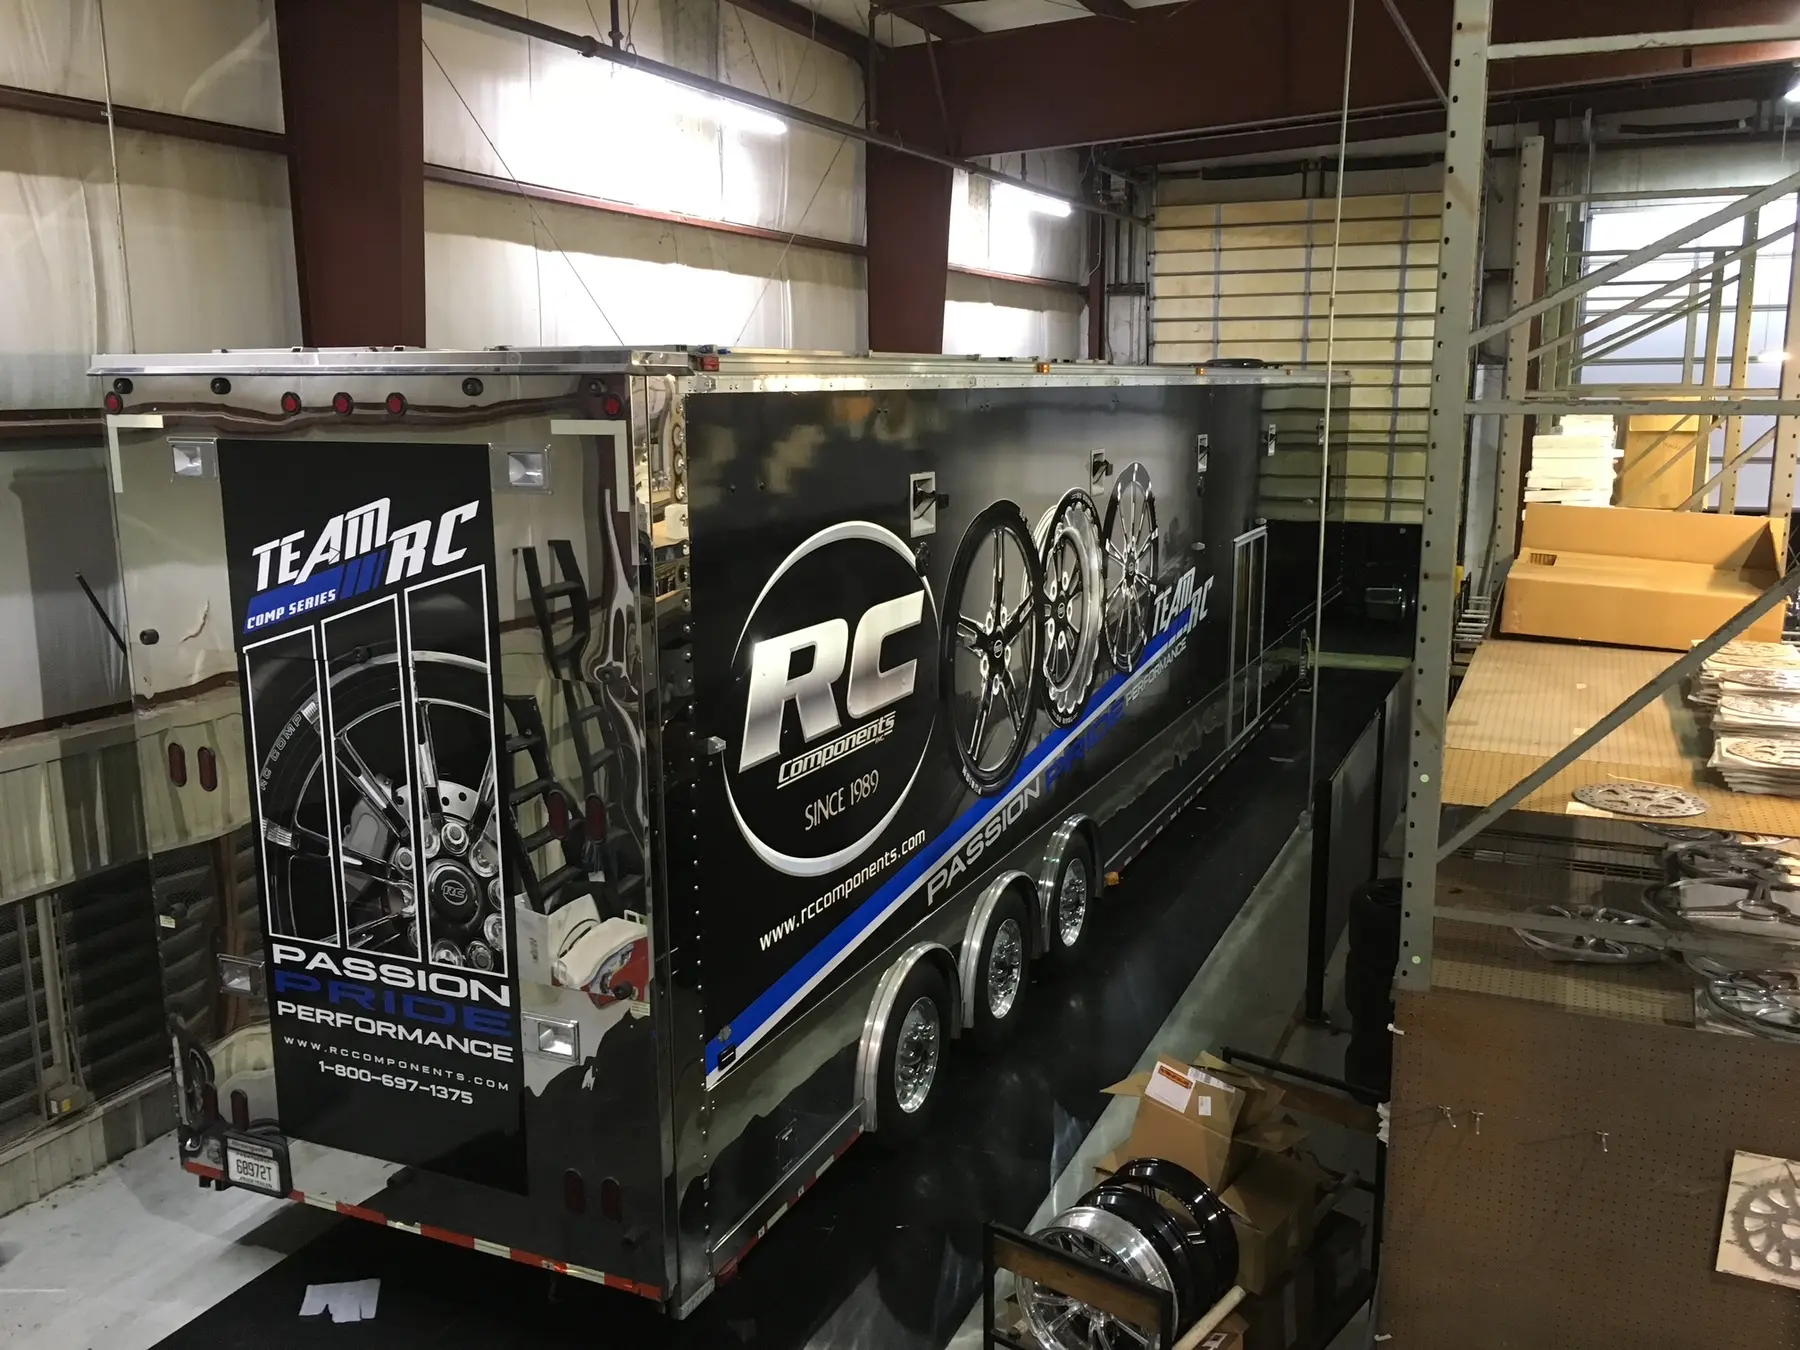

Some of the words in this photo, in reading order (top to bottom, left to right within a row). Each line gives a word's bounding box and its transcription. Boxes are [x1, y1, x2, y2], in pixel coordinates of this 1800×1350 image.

[252, 497, 391, 592] TEAM
[385, 500, 480, 585] RC
[246, 607, 285, 630] COMP
[288, 588, 337, 617] SERIES
[1152, 566, 1196, 638] TEAM
[1187, 574, 1214, 634] RC
[739, 589, 926, 775] RC
[270, 713, 302, 762] COMP
[804, 787, 846, 831] SINCE
[850, 769, 879, 806] 1989
[927, 774, 1041, 906] PASSION
[1044, 693, 1126, 793] PRIDE
[1125, 636, 1187, 707] PERFORMANCE
[759, 829, 926, 951] www.rccomponents.com
[272, 943, 511, 1008] PASSION
[274, 969, 514, 1037] PRIDE
[277, 1000, 514, 1063] PERFORMANCE
[284, 1035, 509, 1091] WWW.RCCOMPONENTS.COM
[318, 1060, 474, 1105] 1-800-697-1375
[236, 1159, 272, 1181] 68972T
